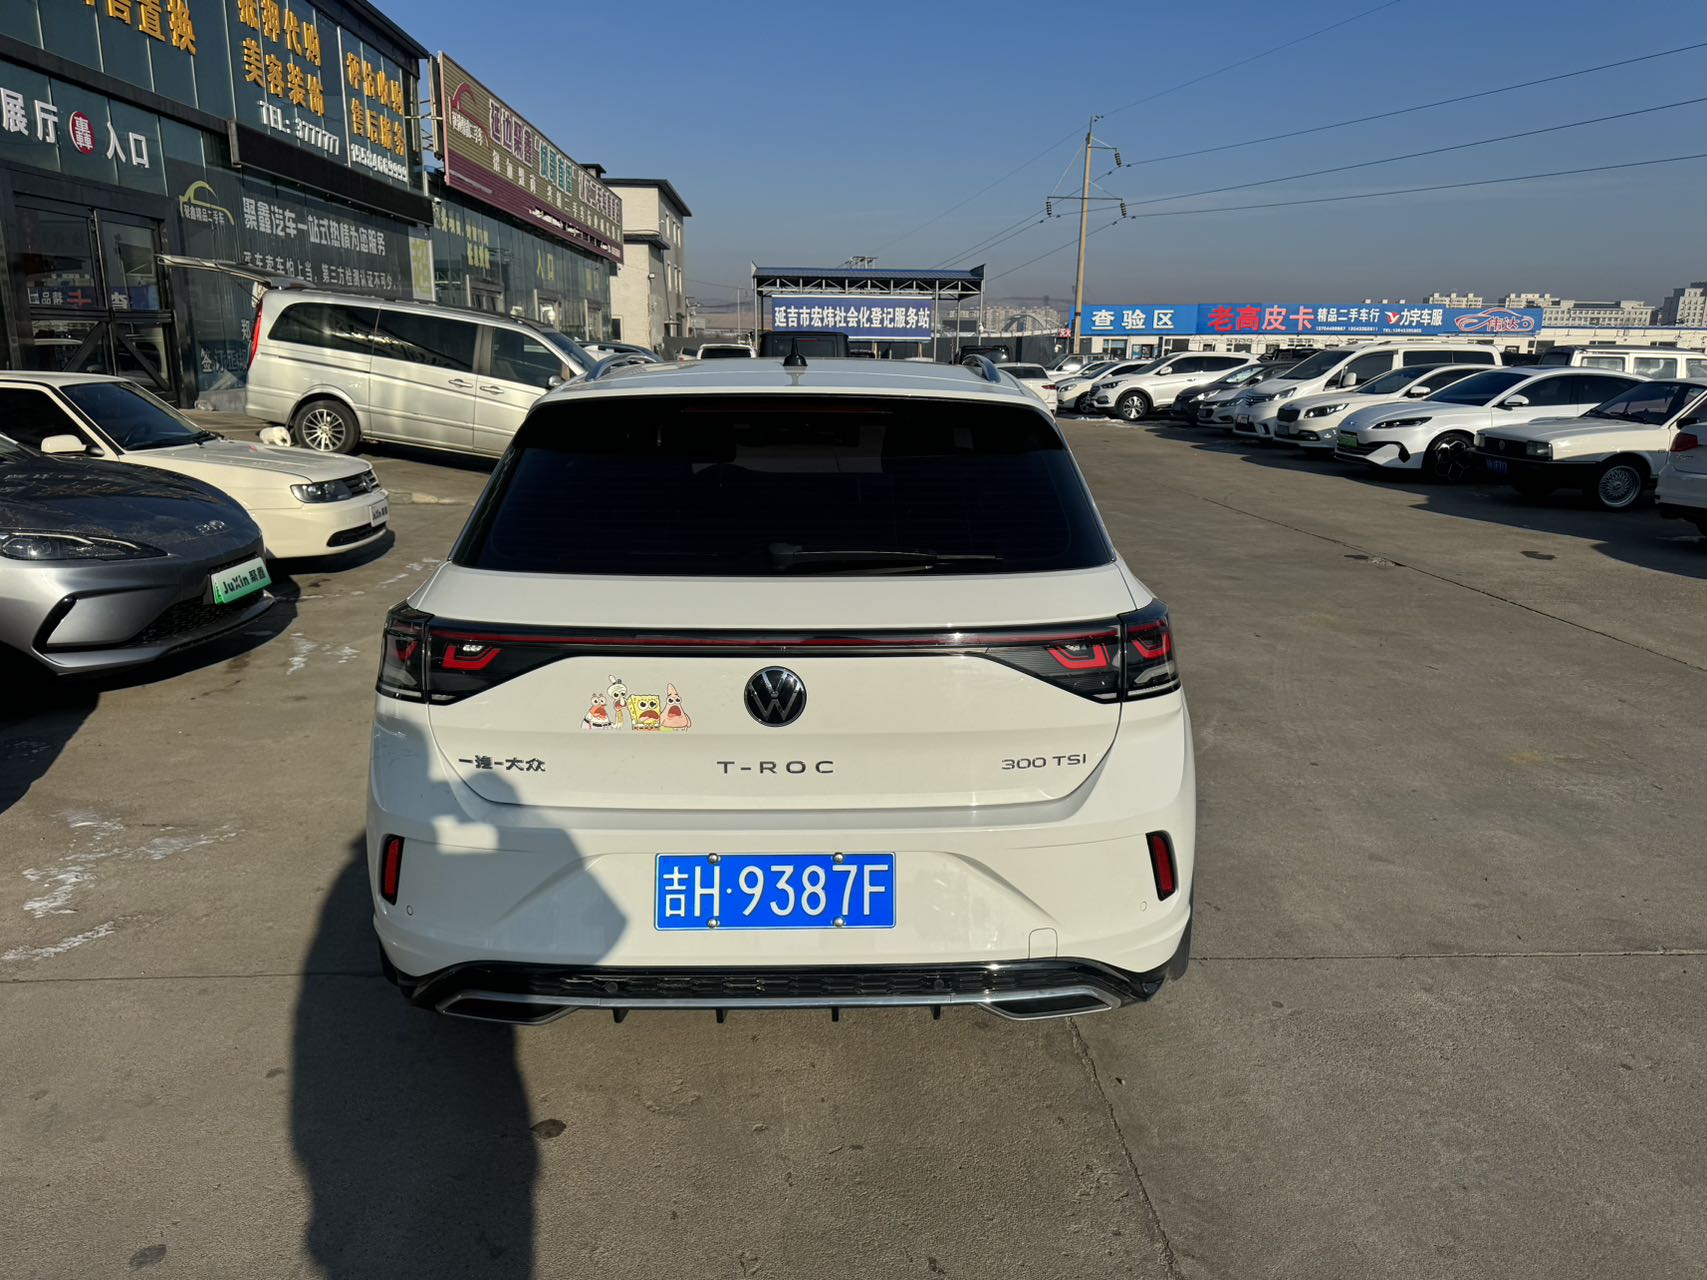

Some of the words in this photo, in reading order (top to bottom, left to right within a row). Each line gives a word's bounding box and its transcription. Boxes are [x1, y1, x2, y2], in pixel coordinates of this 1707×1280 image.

[243, 37, 325, 117] 美容装饰
[0, 87, 58, 143] 展厅
[106, 121, 150, 169] 入口
[242, 196, 386, 256] 聚鑫汽车一站式热情为您服务
[1091, 309, 1175, 330] 查验区
[1208, 304, 1315, 332] 老高皮卡
[1317, 307, 1380, 323] 精品二手车行
[222, 574, 250, 594] JuXin
[716, 760, 834, 774] T-ROC
[1001, 757, 1047, 770] 300
[1052, 753, 1087, 766] TSI
